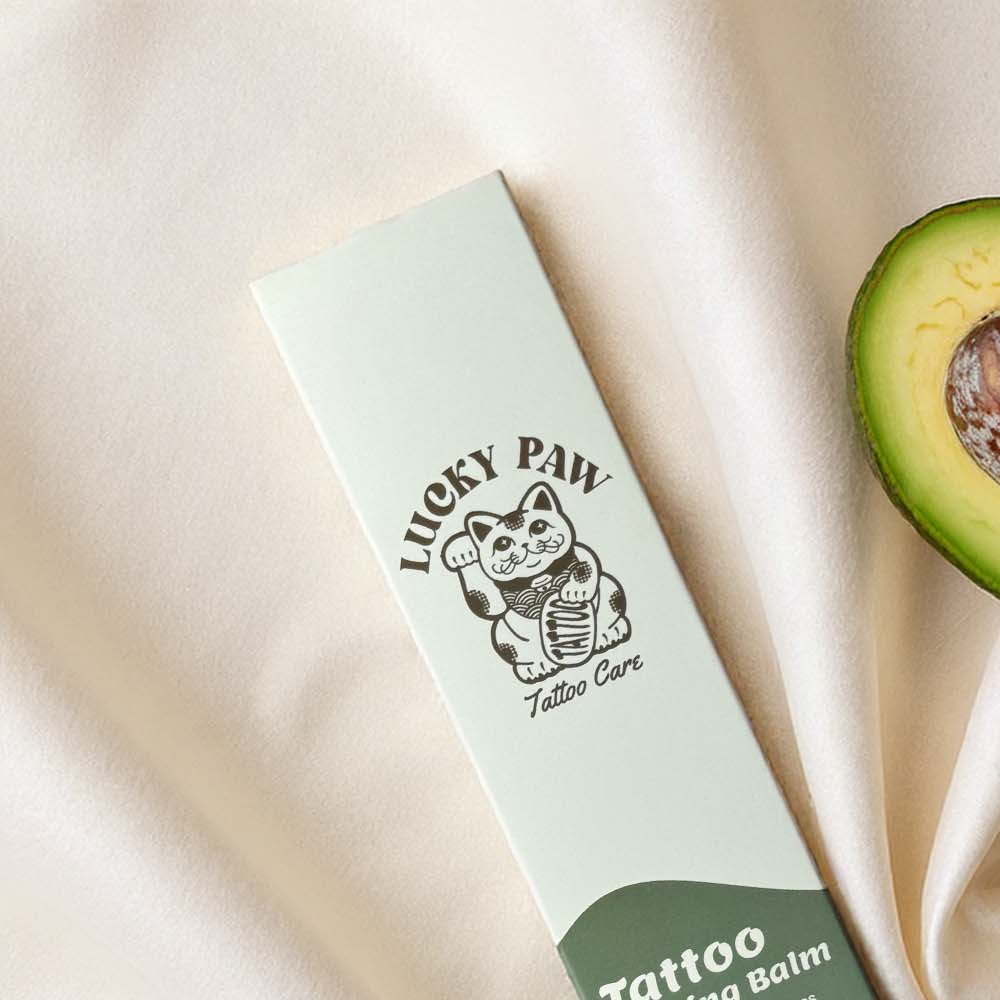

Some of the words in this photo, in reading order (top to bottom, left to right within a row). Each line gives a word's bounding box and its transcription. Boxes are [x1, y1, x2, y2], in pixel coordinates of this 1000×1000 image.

[400, 444, 499, 574] LUCKY
[516, 436, 613, 494] PAW
[524, 680, 587, 718] Tattoo
[594, 654, 643, 687] Care
[746, 942, 832, 994] Balm
